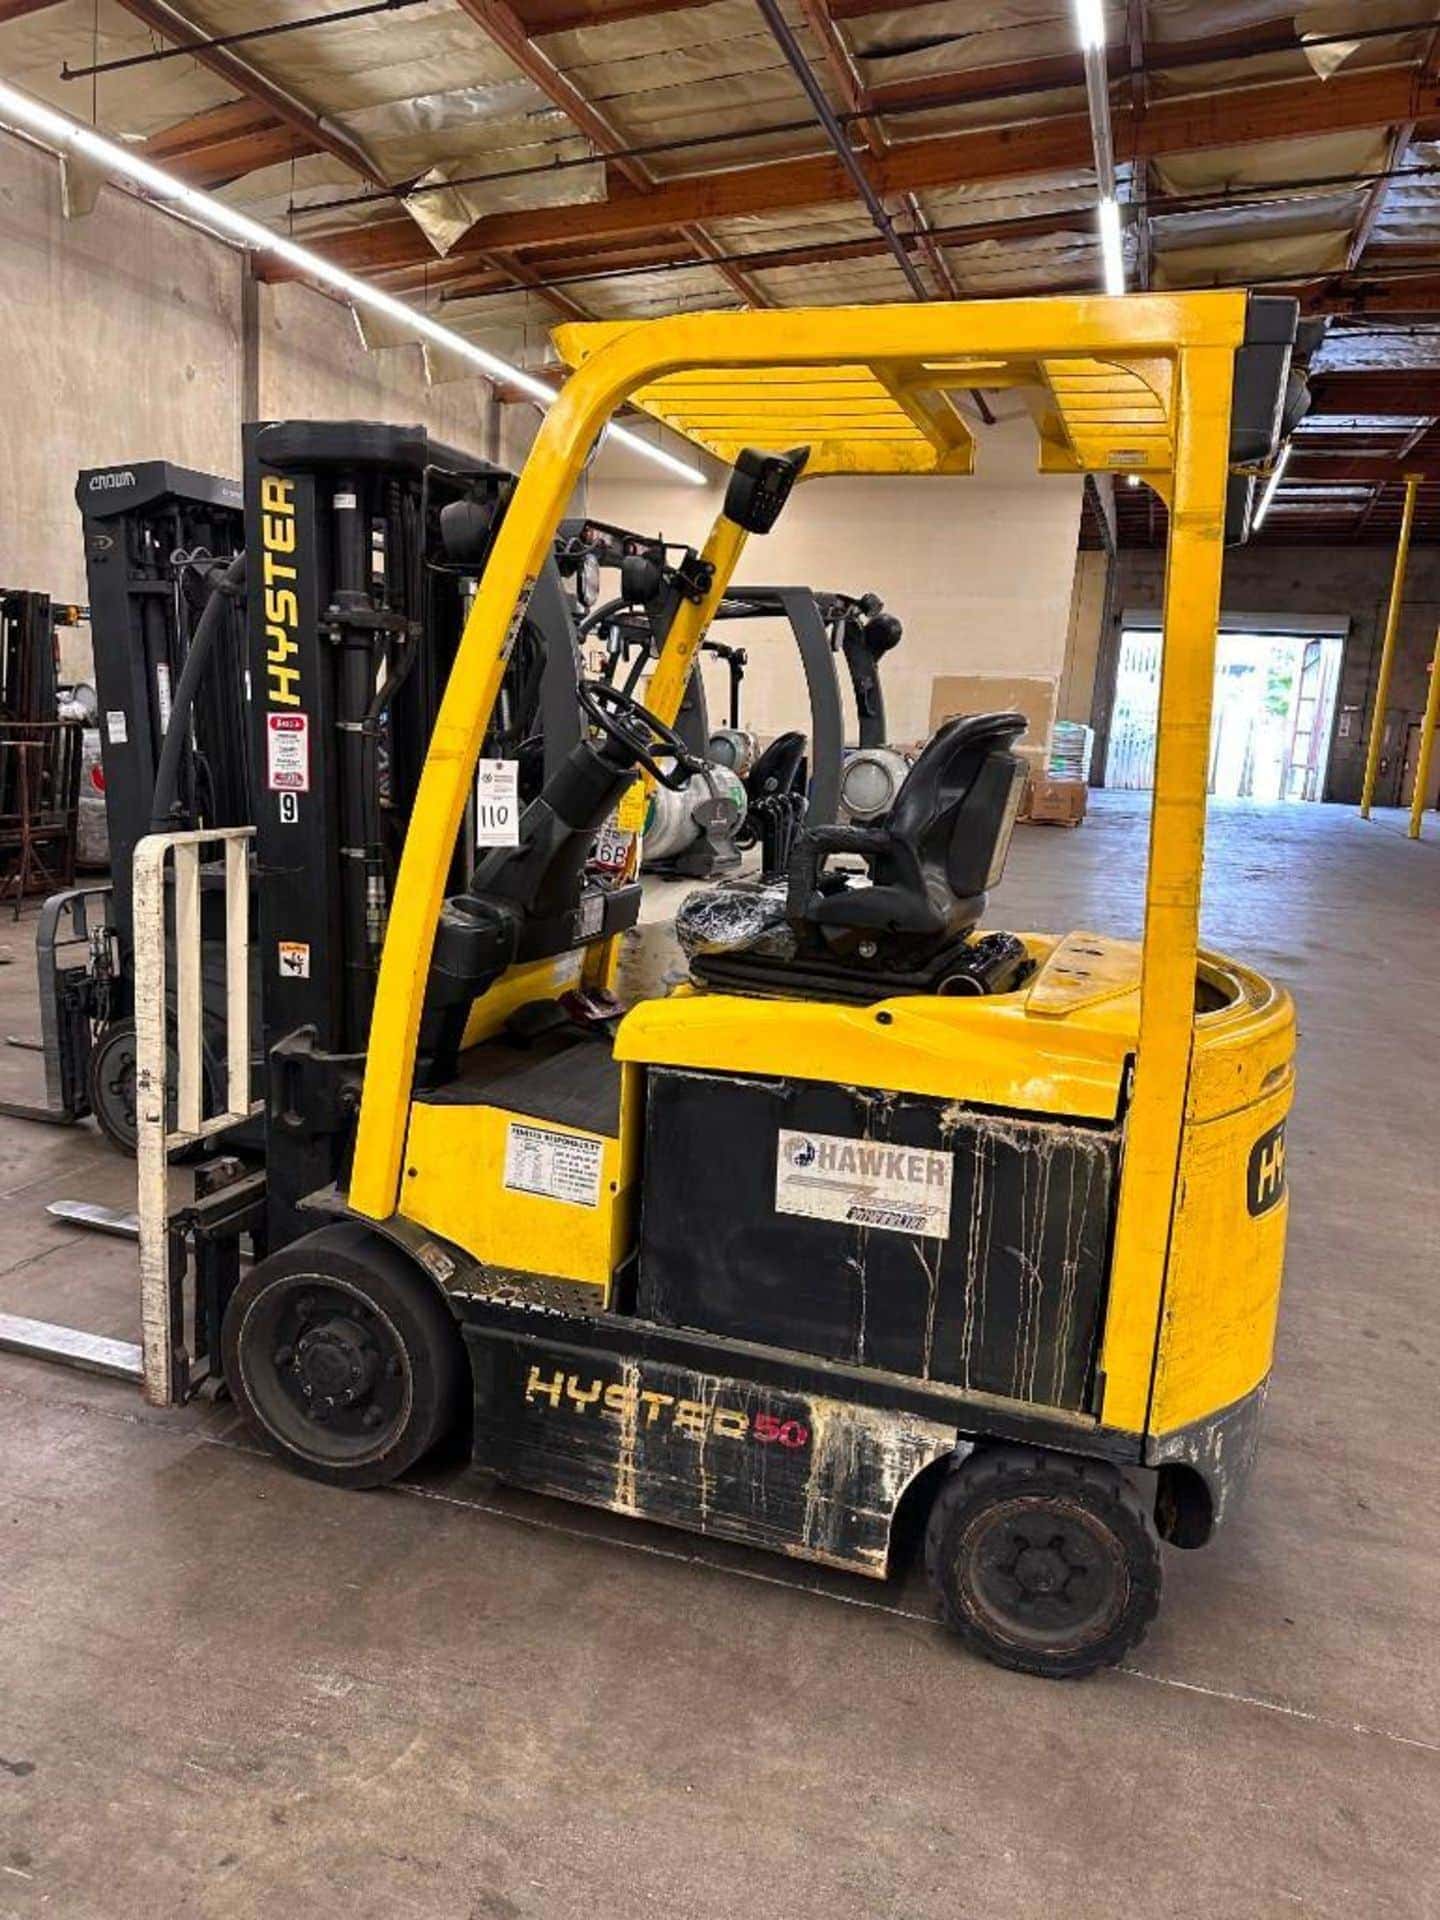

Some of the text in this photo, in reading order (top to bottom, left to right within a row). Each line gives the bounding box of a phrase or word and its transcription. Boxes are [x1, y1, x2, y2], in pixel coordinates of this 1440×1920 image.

[261, 475, 300, 706] HYSTER
[282, 794, 295, 821] 9
[481, 806, 509, 829] 110
[817, 1142, 945, 1186] HAWKER
